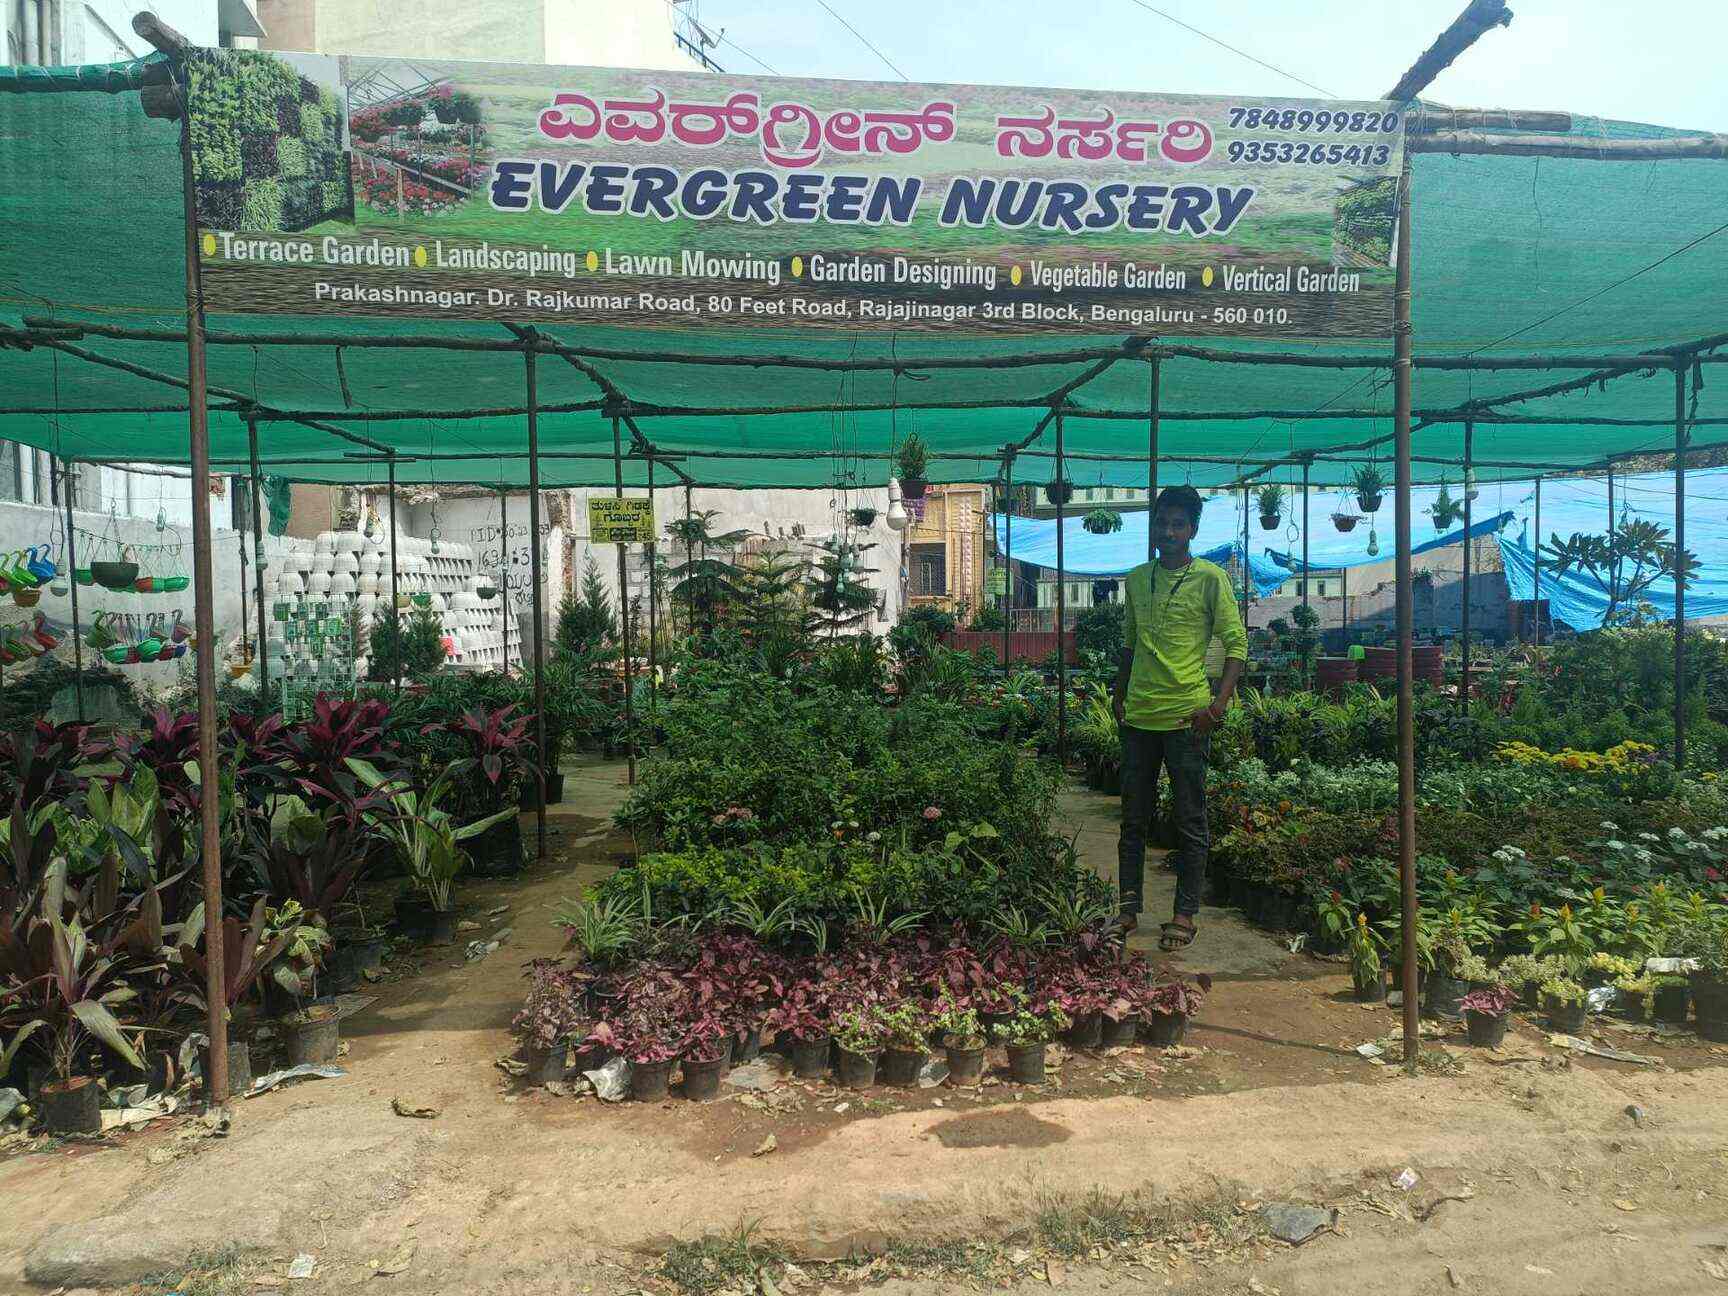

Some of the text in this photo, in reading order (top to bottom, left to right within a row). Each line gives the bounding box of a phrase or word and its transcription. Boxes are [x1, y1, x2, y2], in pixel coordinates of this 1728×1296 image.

[997, 104, 1213, 163] ನರ್ಸರಿ
[1228, 106, 1400, 134] 7848999820
[1227, 140, 1391, 166] 9353265413
[490, 161, 1254, 234] EVERGREEN NURSERY
[219, 231, 410, 267] Terrace Garden
[435, 240, 576, 279] Landscaping
[605, 247, 780, 287] Lawn Mowing
[810, 254, 996, 291] Garden Designing
[1030, 260, 1187, 293] Vegetable Garden
[1222, 264, 1360, 292] Vertical Garden
[315, 282, 480, 308] Prakashnagar.
[487, 288, 519, 306] Dr.
[526, 289, 632, 312] Rajkumar
[639, 293, 701, 315] Road,
[708, 295, 733, 313] 80
[740, 297, 787, 315] Feet
[792, 299, 853, 319] Road,
[860, 300, 977, 321] Rajajinagar
[982, 301, 1015, 319] 3rd
[1021, 303, 1085, 323] Block,
[1091, 305, 1194, 325] Bengaluru
[1213, 307, 1248, 324] 560
[1253, 308, 1294, 325] 010.
